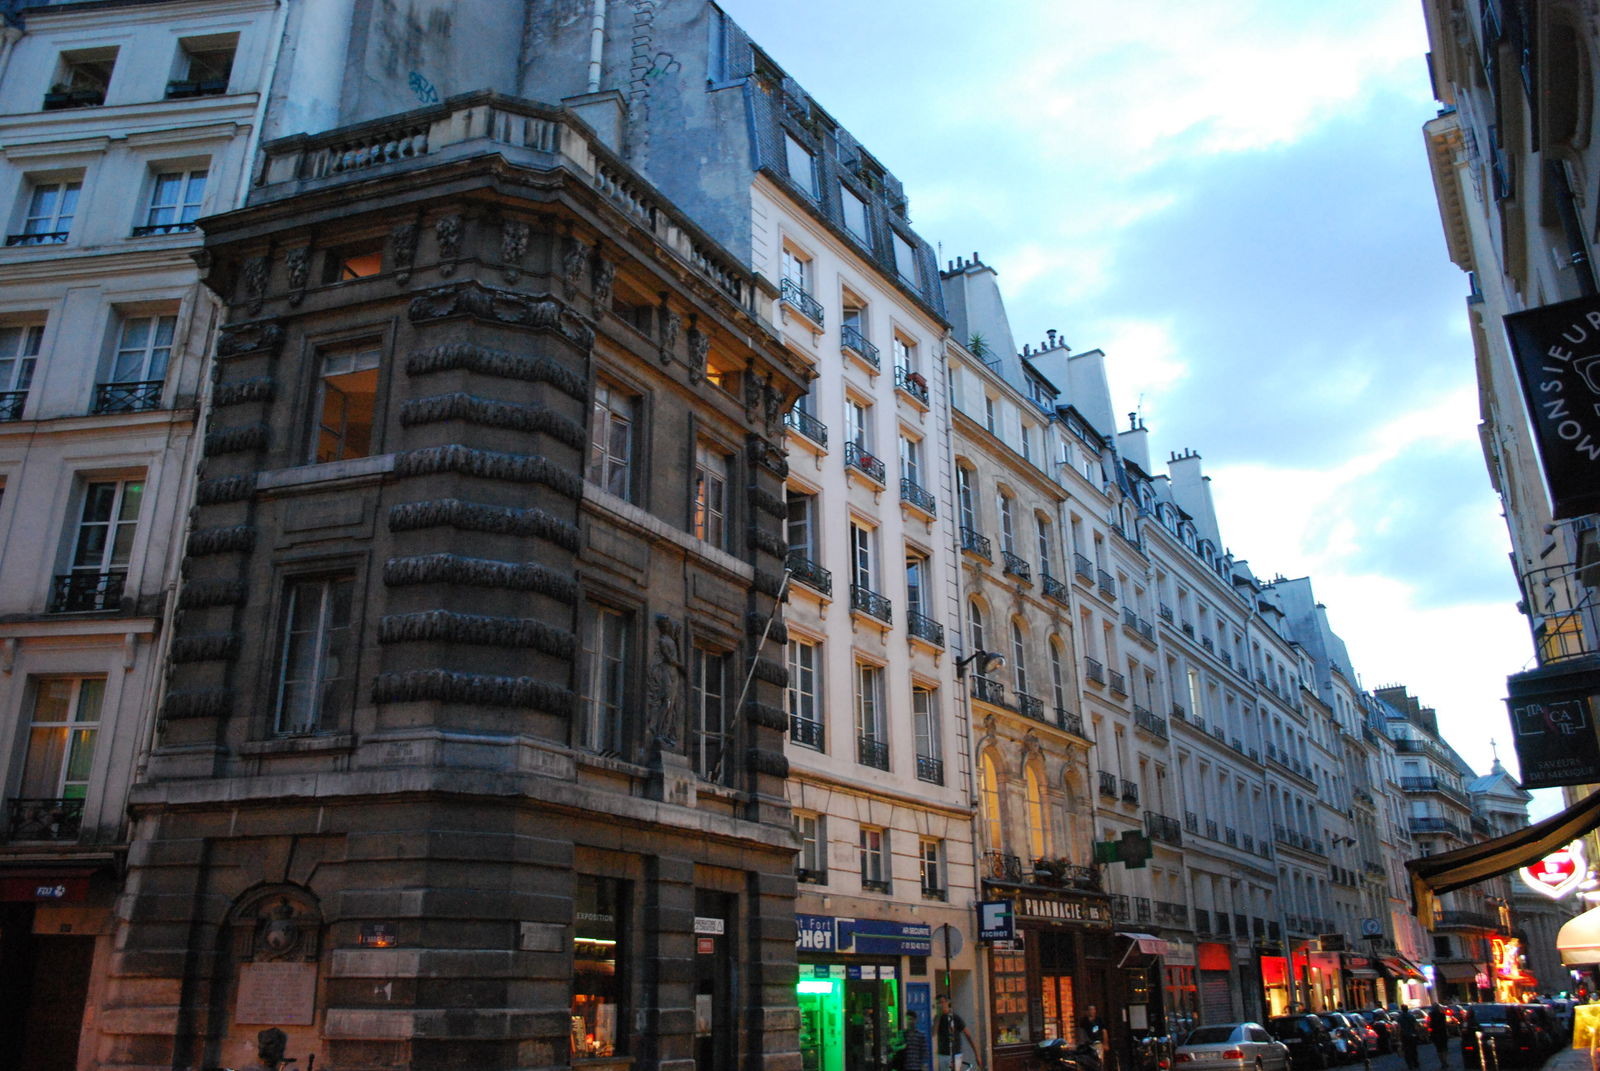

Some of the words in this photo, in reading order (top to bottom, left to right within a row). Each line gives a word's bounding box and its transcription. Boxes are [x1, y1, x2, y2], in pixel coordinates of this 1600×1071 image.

[1540, 311, 1600, 461] MONSIEUR
[576, 912, 613, 921] EXPOSITION
[1025, 899, 1082, 919] PHARMACIE
[810, 918, 831, 930] Fort
